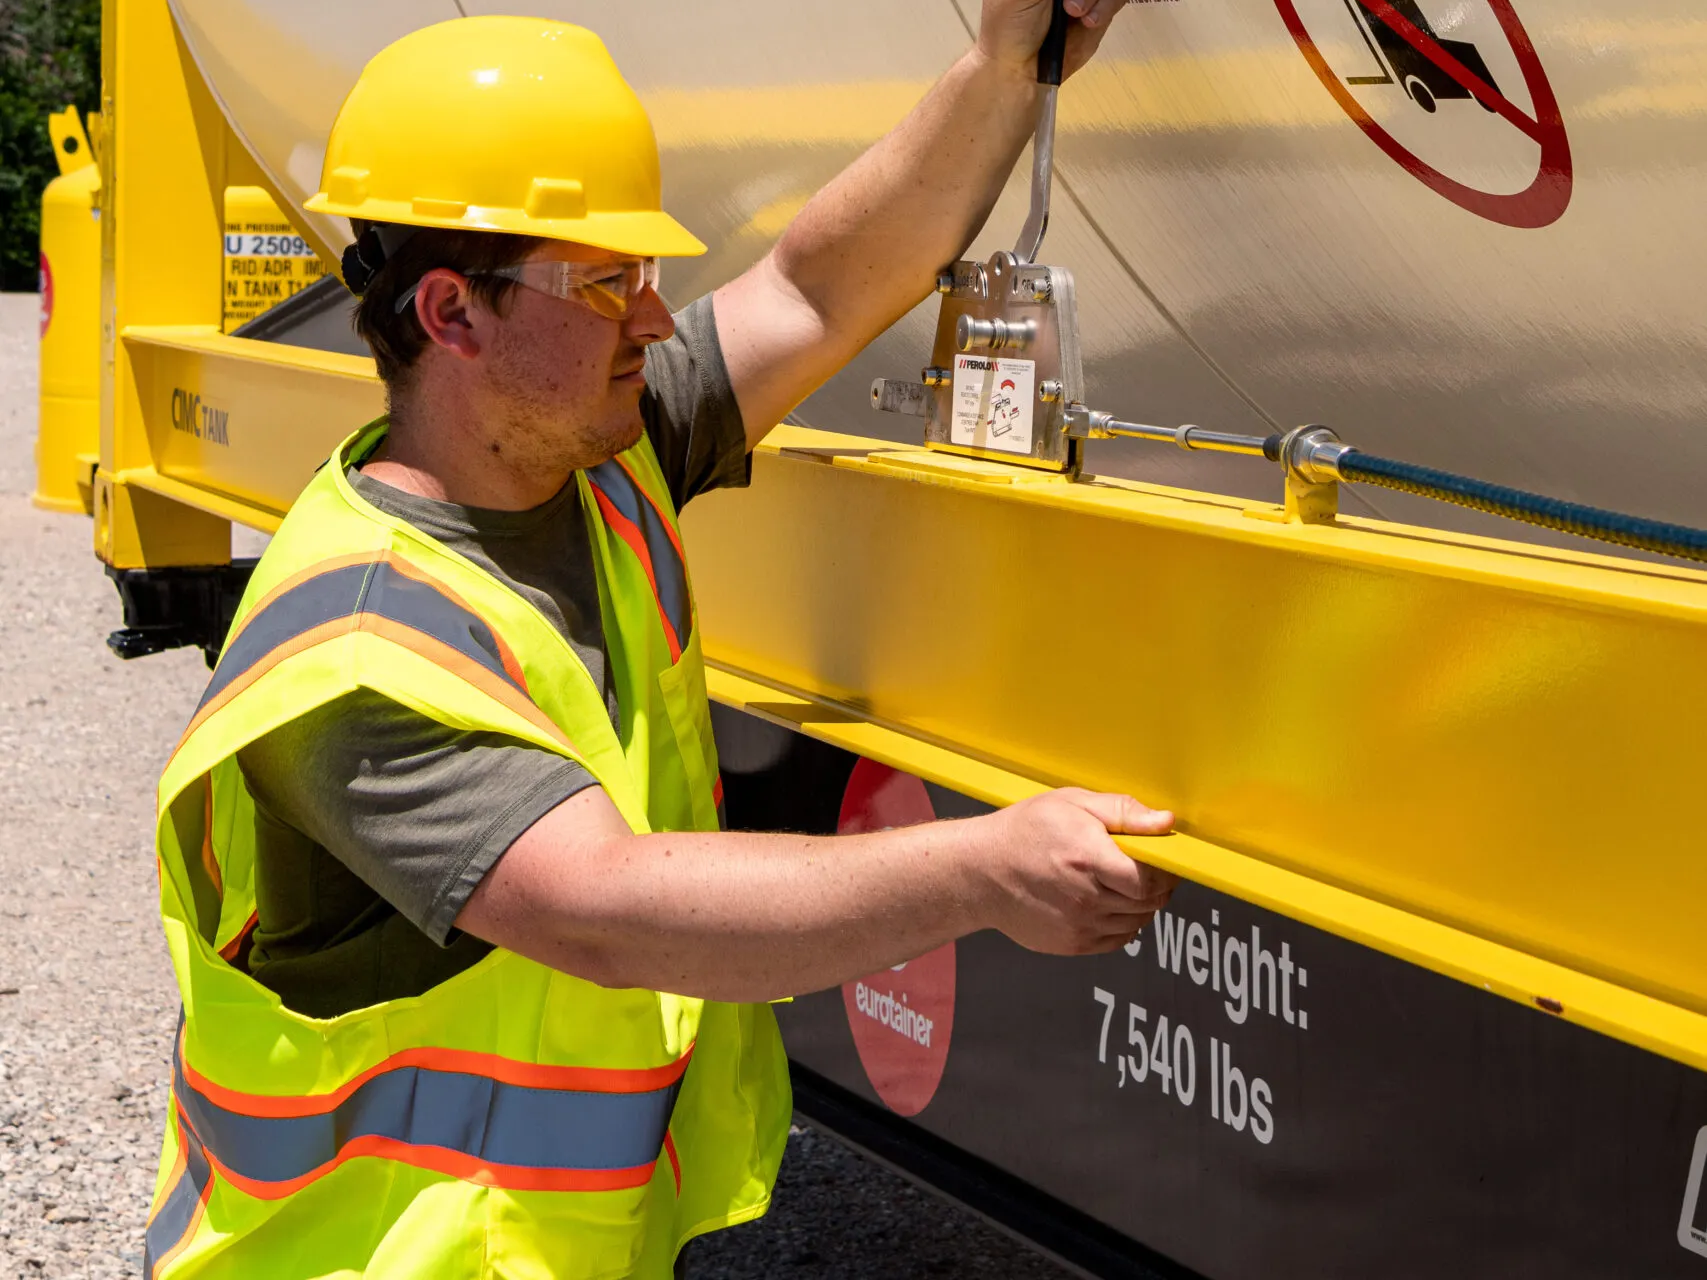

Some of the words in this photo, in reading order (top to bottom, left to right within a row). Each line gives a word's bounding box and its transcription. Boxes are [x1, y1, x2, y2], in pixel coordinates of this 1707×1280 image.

[245, 280, 282, 297] TANK
[966, 360, 992, 372] PEROLO
[202, 404, 230, 447] TANK
[1153, 908, 1309, 1031] weight:
[855, 980, 934, 1049] eurotainer
[1092, 985, 1196, 1106] 7,540
[1209, 1036, 1275, 1145] lbs
